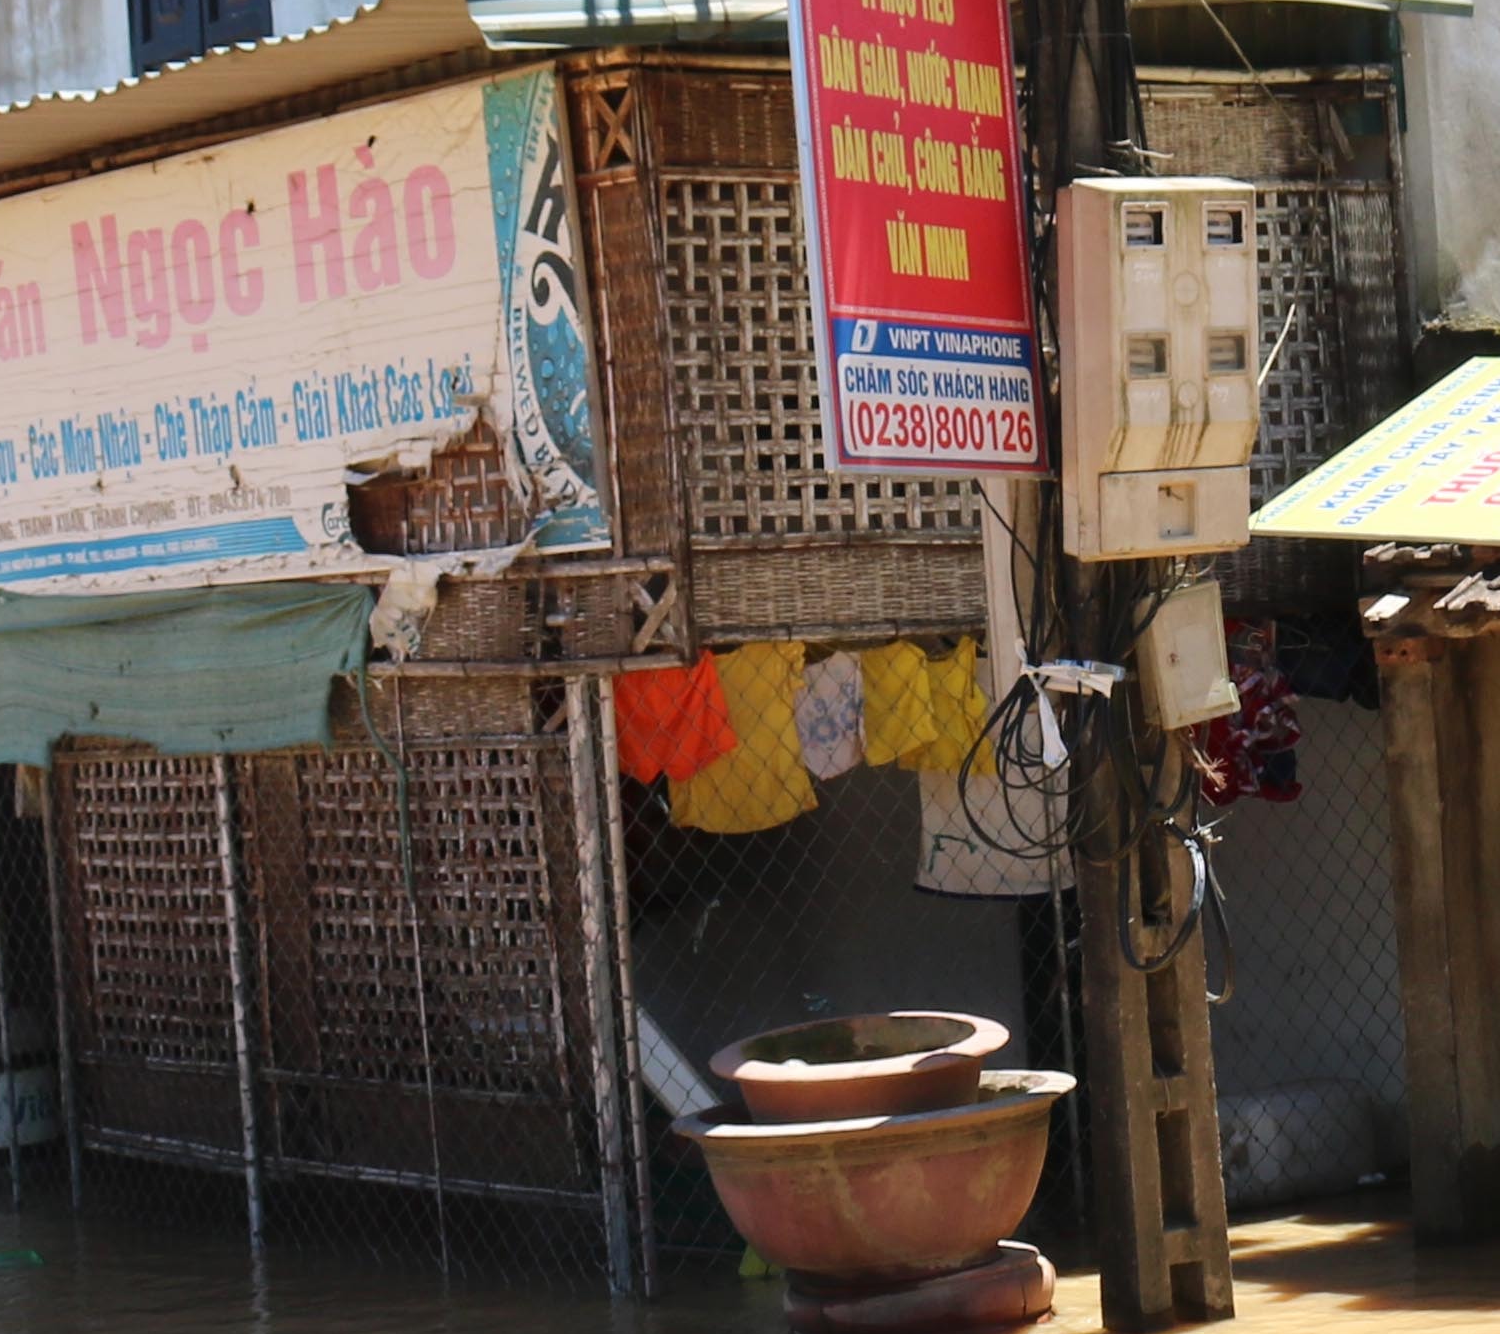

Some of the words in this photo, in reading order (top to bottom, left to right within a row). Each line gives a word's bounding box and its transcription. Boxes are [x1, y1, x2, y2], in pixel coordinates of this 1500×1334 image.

[819, 25, 857, 93] DÂN
[906, 40, 952, 109] NƯỚC
[954, 59, 1002, 126] MẠNH
[831, 115, 870, 182] DÂN
[913, 128, 960, 195] CÔNG
[961, 122, 1006, 201] BẰNG
[70, 208, 265, 353] Ngọc
[886, 210, 922, 276] VĂN
[924, 224, 970, 281] MINH
[511, 305, 540, 437] BREWED
[888, 328, 930, 352] VNPT
[934, 331, 1022, 359] VINAPHONE
[845, 363, 892, 394] CHĂM
[898, 365, 928, 396] SÓC
[933, 369, 984, 400] KHÁCH
[989, 371, 1029, 402] HÀNG
[28, 419, 60, 480] Các
[60, 414, 97, 474] Món
[97, 407, 143, 482] Nhậu
[154, 395, 188, 461] Chè
[189, 392, 232, 465] Thập
[235, 374, 277, 449] Cẩm
[334, 364, 382, 435] Khát
[384, 356, 423, 424] Các
[850, 400, 1033, 453] (0238)800126
[1459, 427, 1489, 436] Y
[1312, 464, 1394, 509] KHÁM
